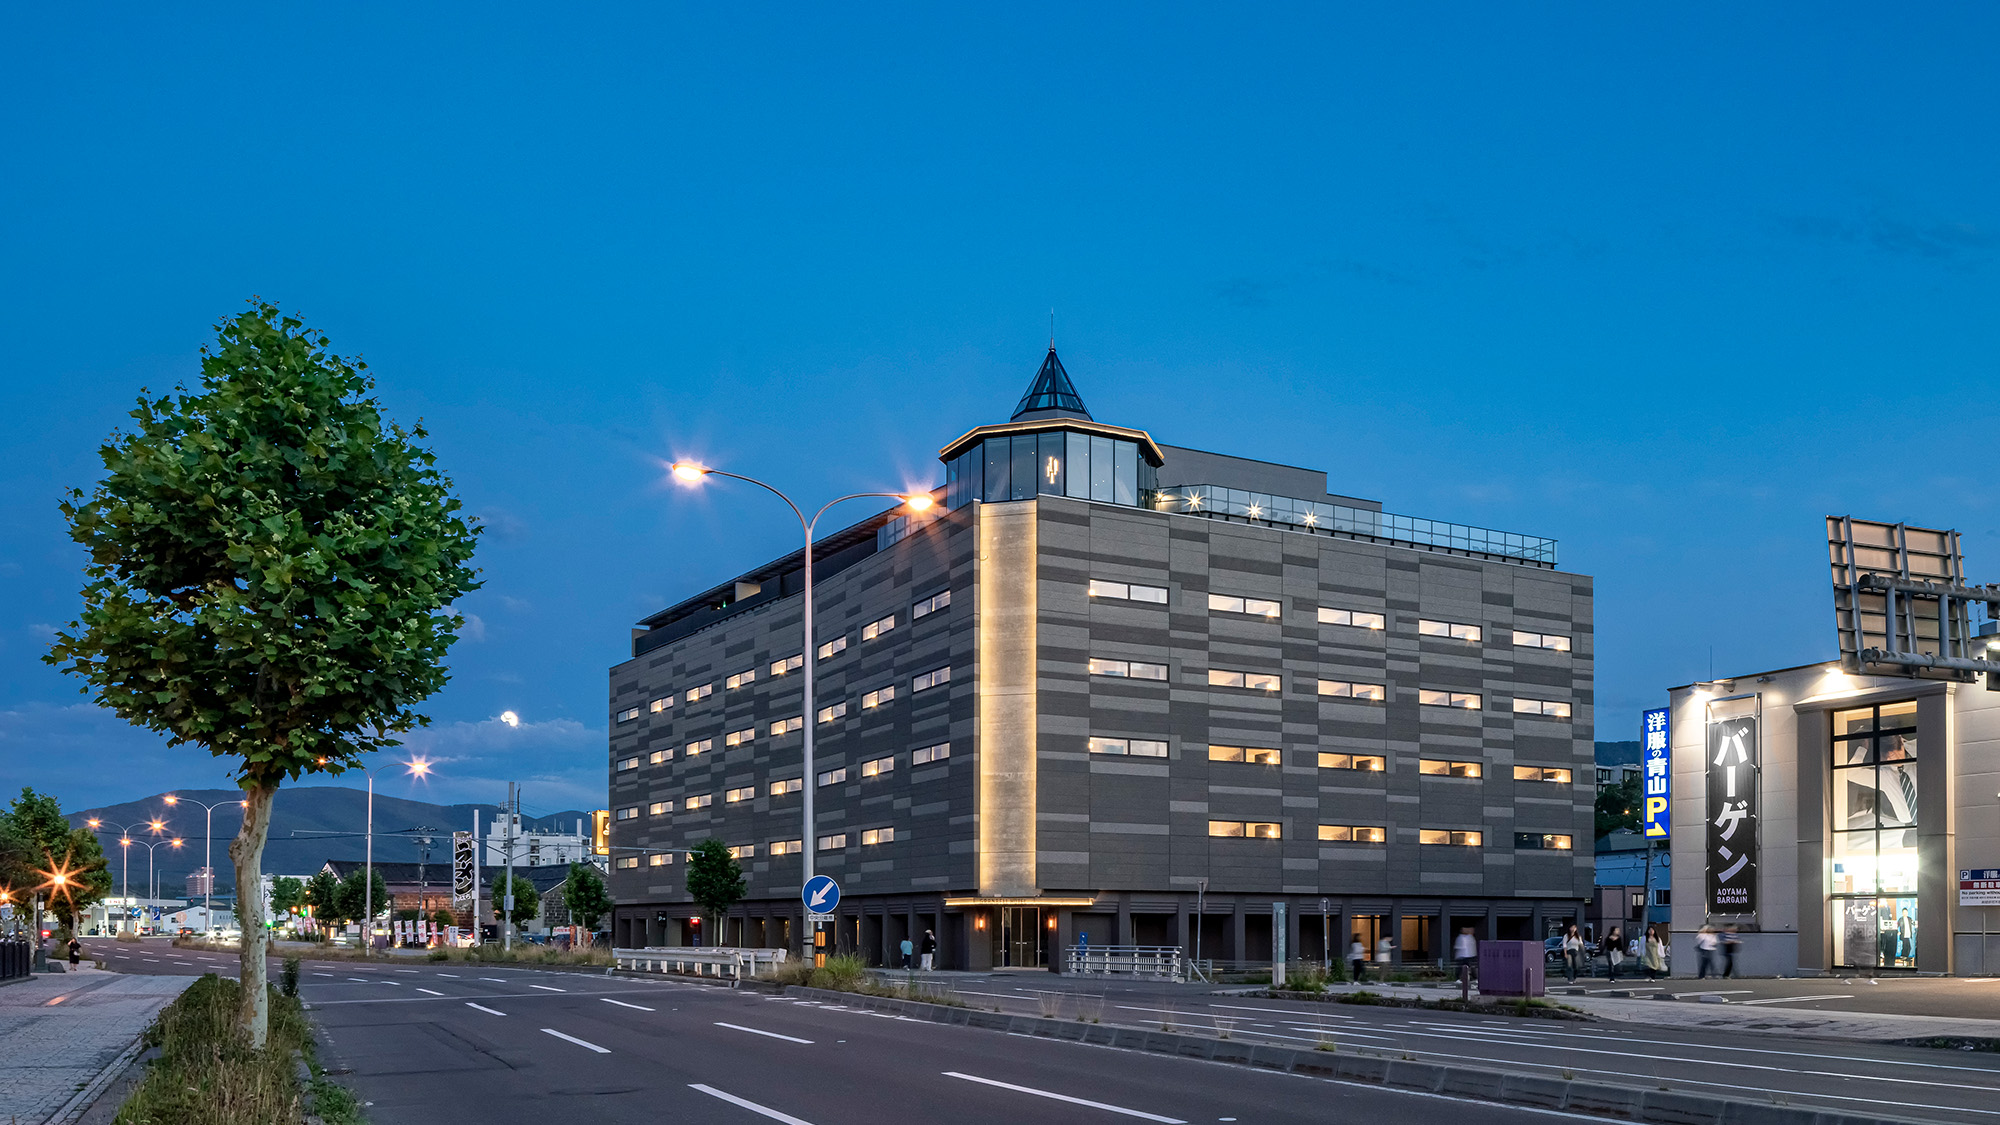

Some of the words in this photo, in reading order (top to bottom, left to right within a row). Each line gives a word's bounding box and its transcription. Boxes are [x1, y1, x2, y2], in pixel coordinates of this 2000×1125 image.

[1646, 711, 1667, 795] 洋服の青山
[1646, 796, 1667, 823] P
[1713, 726, 1749, 883] バーゲン
[1716, 888, 1748, 896] AOYAMA
[1716, 896, 1748, 904] BARGAIN
